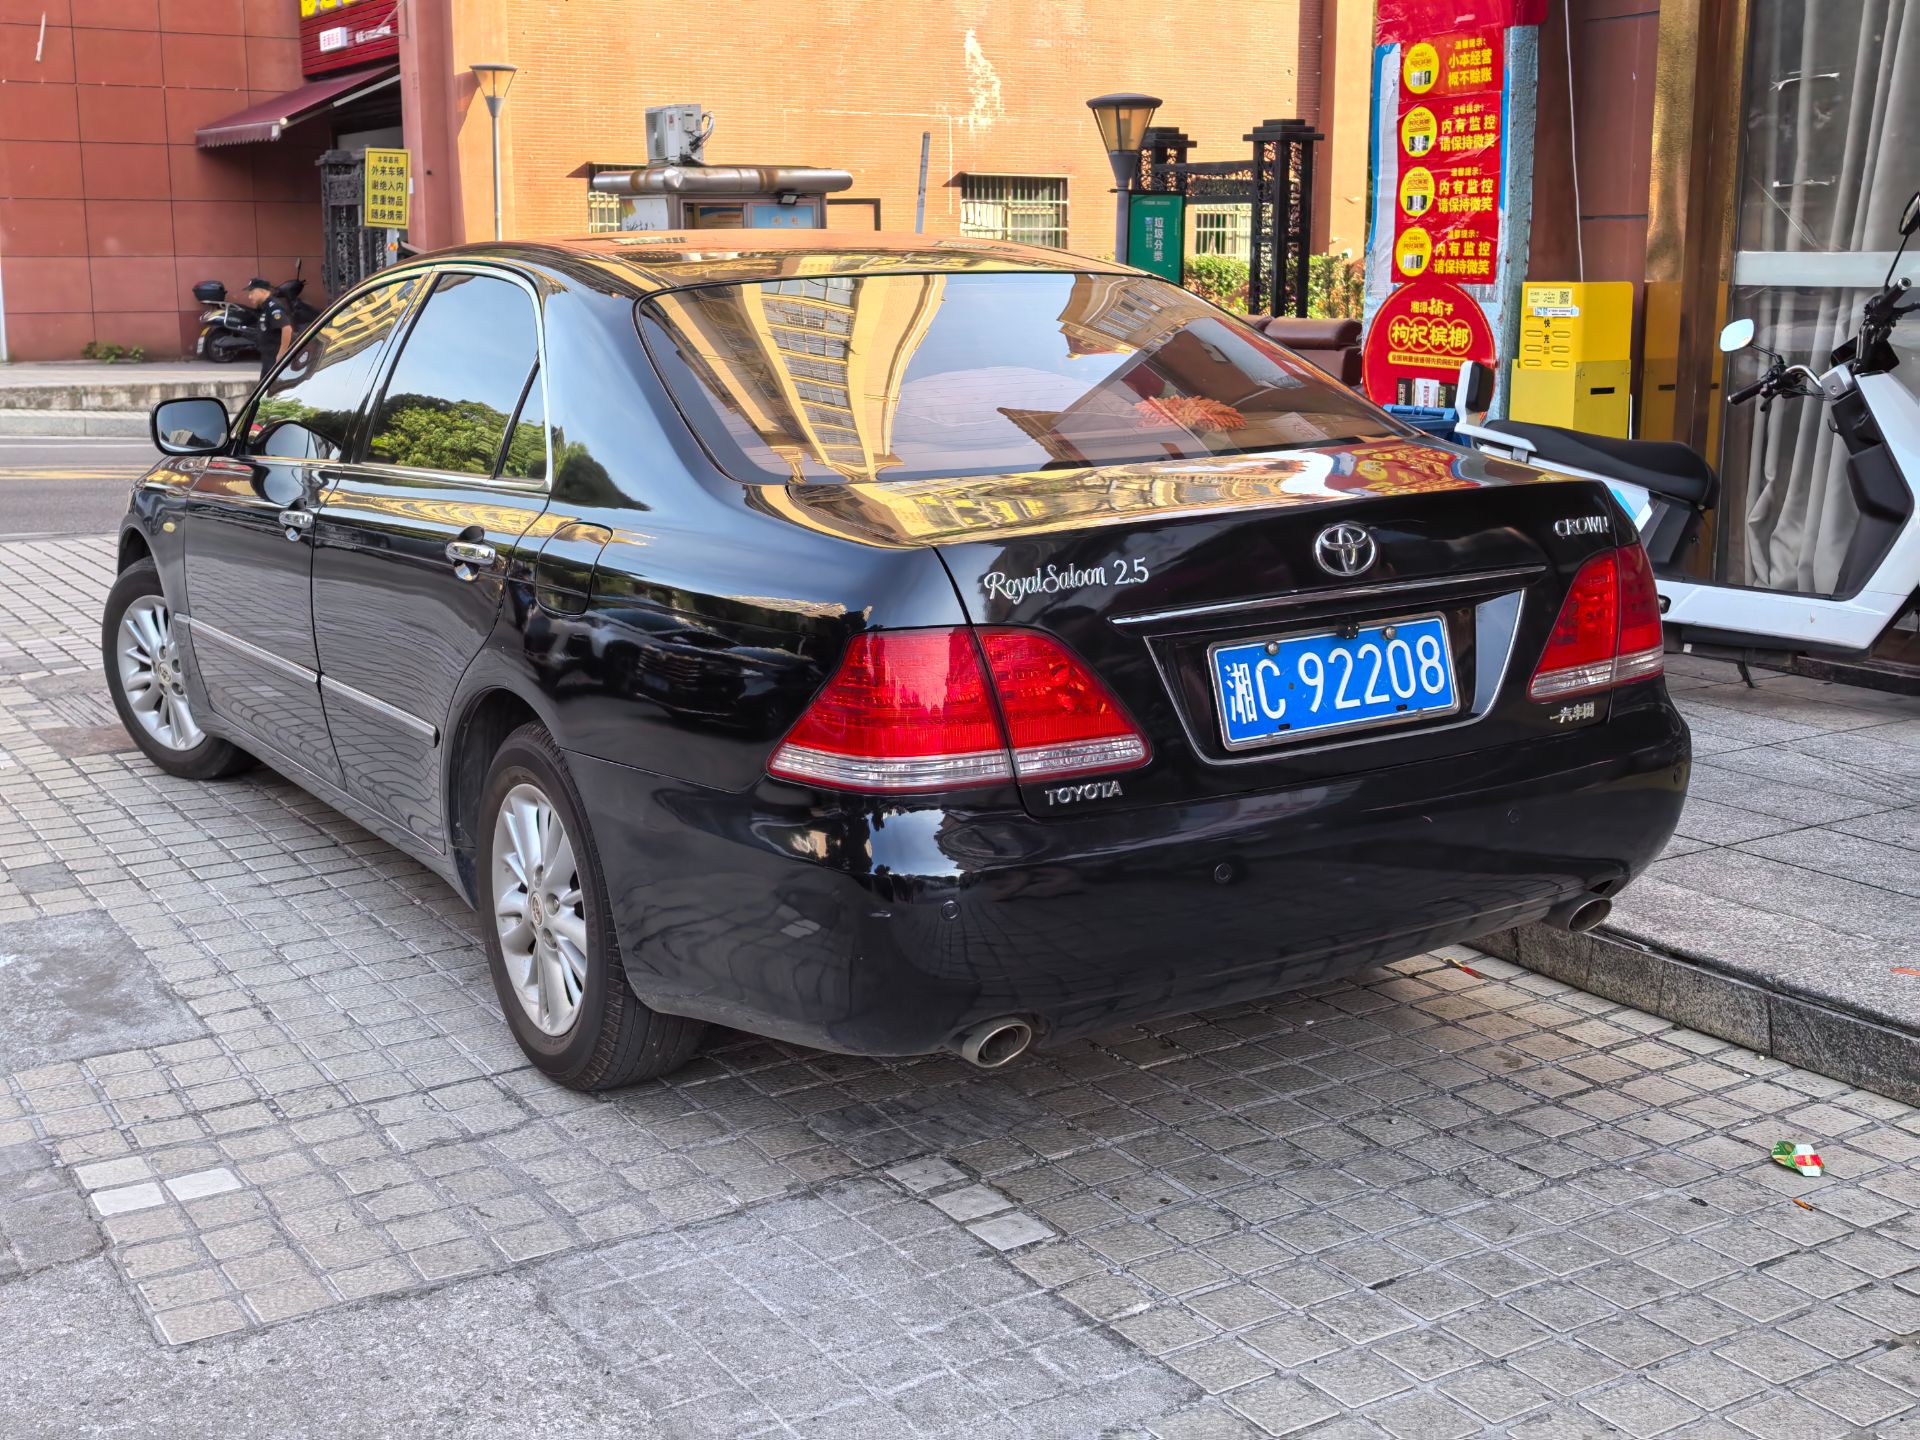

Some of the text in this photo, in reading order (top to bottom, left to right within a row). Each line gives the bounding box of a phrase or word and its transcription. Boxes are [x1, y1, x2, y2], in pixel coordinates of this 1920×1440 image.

[1447, 47, 1493, 70] 小本经营
[1447, 66, 1492, 87] 概不赊账
[1440, 114, 1497, 134] 内有监控
[1439, 132, 1496, 152] 请保持微笑
[371, 165, 404, 178] 外来车辆
[371, 180, 404, 192] 谢绝入内
[1439, 177, 1495, 196] 内有监控
[371, 194, 404, 207] 贵重物品
[1438, 196, 1494, 213] 请保持微笑
[371, 208, 404, 221] 随身携带
[1154, 217, 1165, 262] 垃圾分类
[1435, 241, 1491, 257] 内有监控
[1434, 259, 1490, 275] 请保持微笑
[1410, 297, 1454, 316] 湘潭铺子
[1391, 321, 1470, 349] 枸杞槟榔
[1553, 515, 1611, 538] CROWN
[983, 556, 1150, 606] Royal Saloon 2.5
[1224, 634, 1446, 725] 湘C 92208
[1044, 780, 1123, 806] TOYOTA
